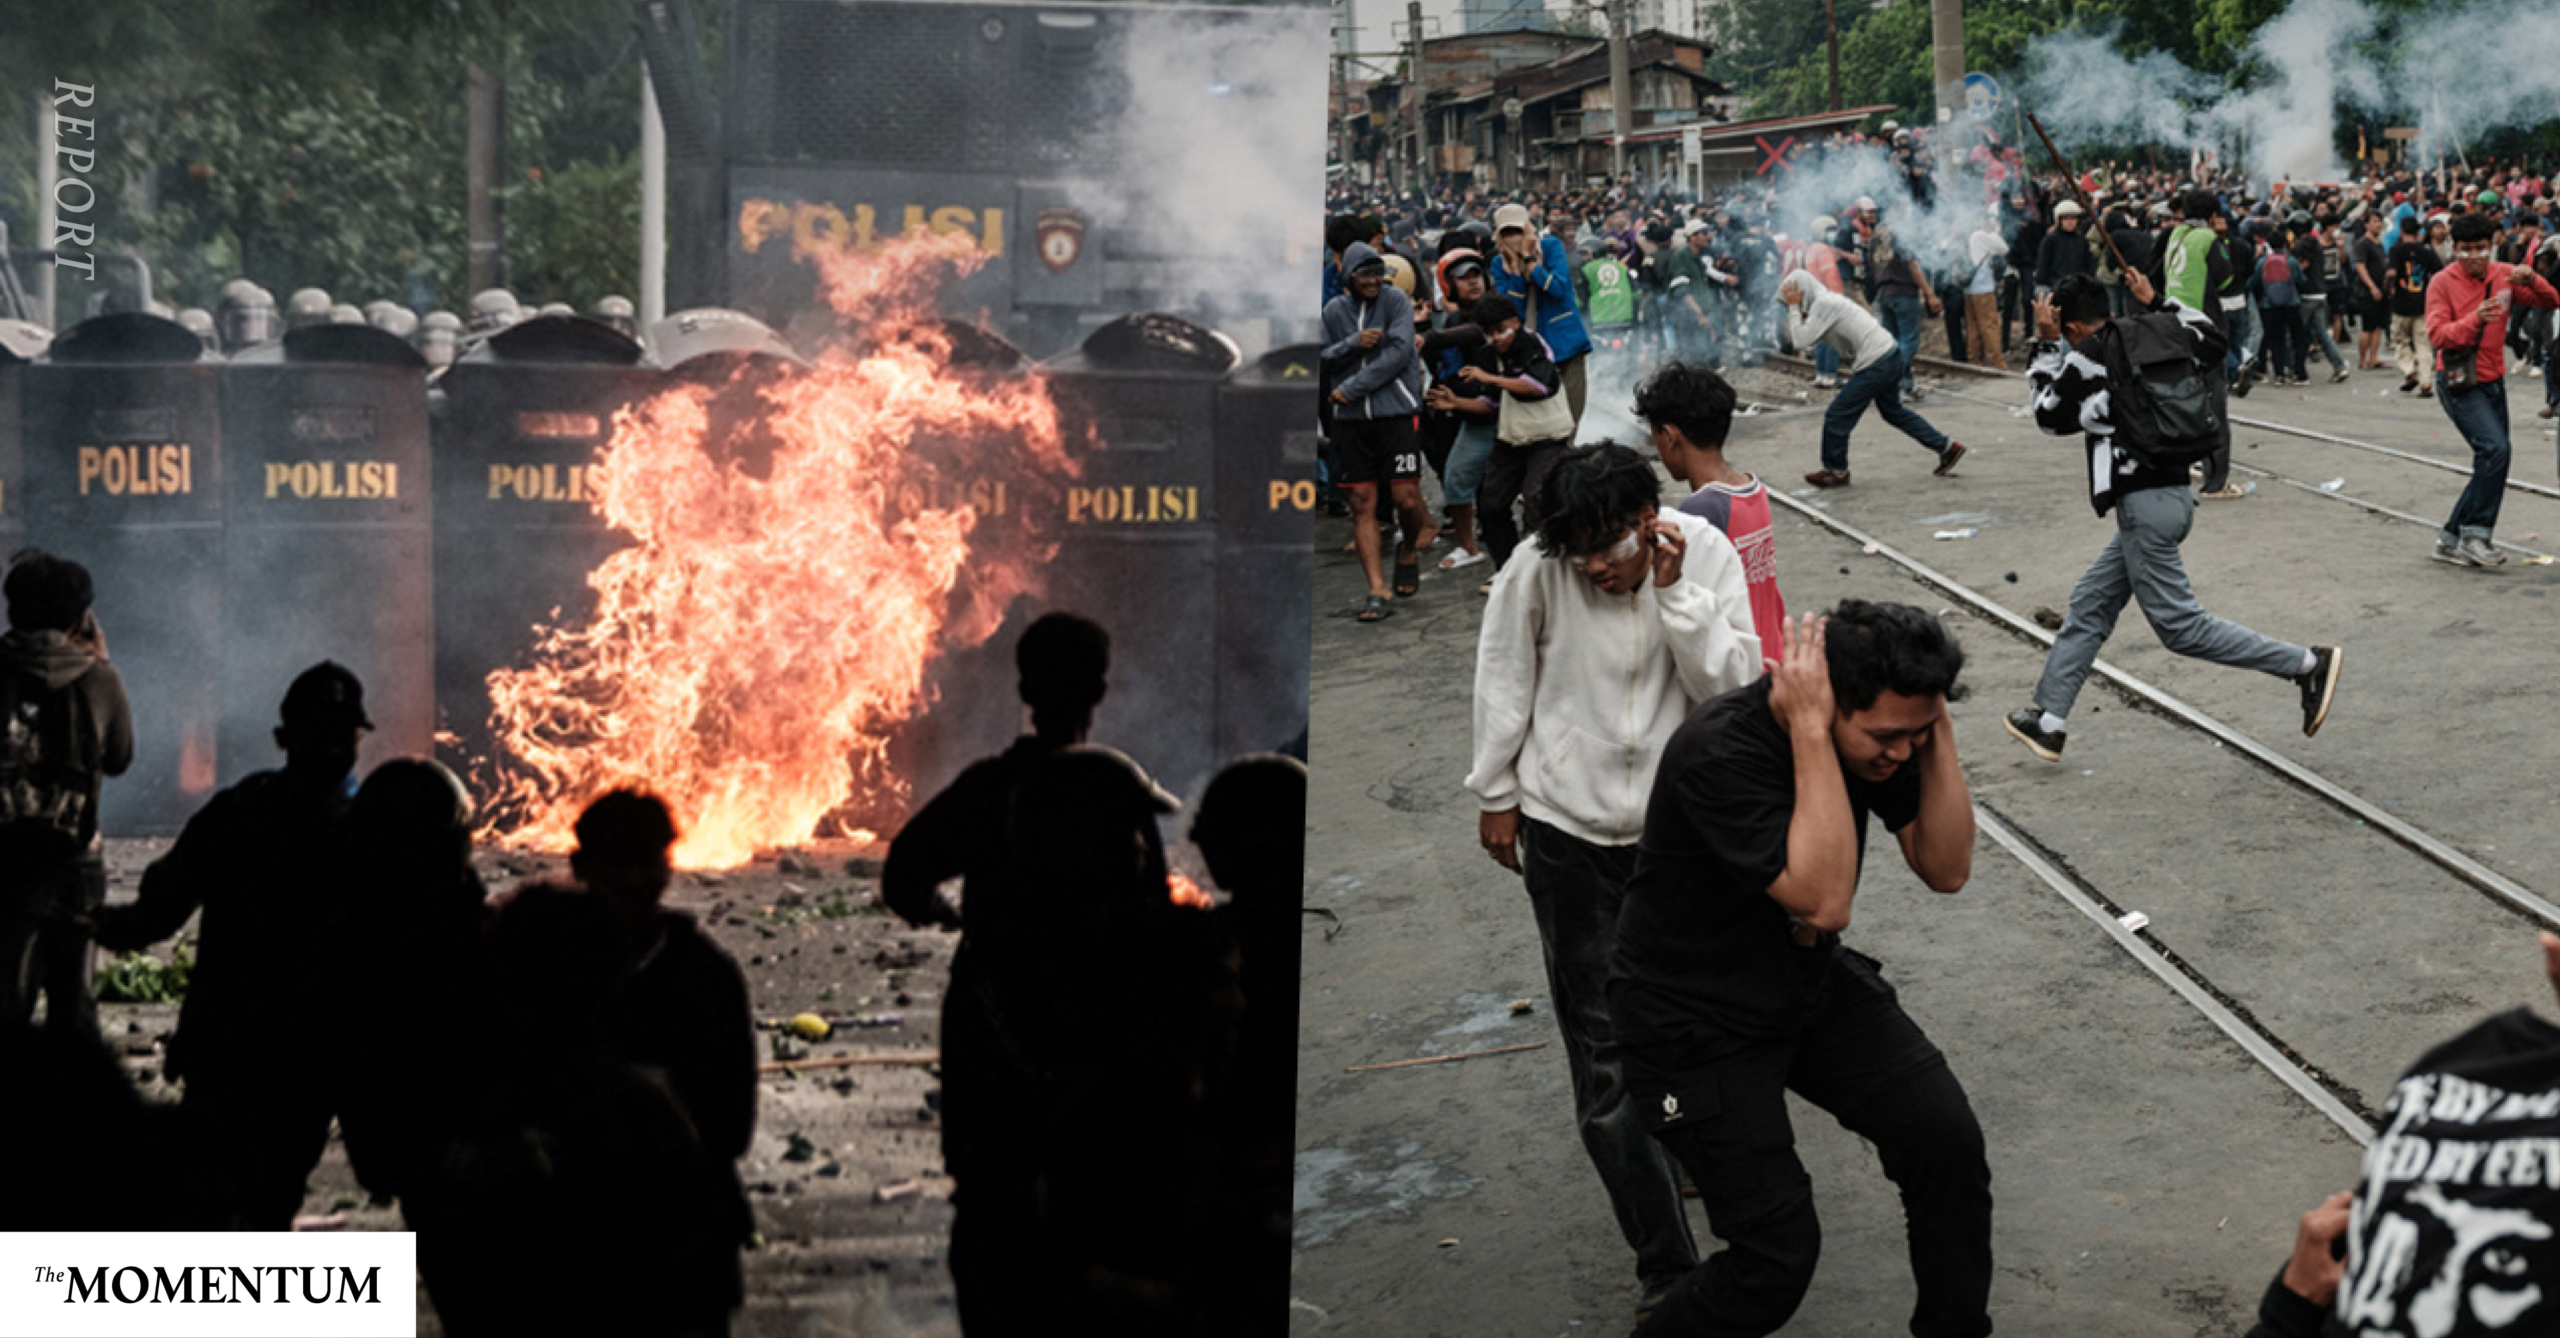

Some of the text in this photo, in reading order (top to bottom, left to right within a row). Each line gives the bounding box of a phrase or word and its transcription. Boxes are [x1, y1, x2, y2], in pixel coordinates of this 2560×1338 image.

[79, 444, 191, 495] POLISI
[265, 462, 397, 498] POLISI
[487, 462, 610, 501] POLIS
[1395, 454, 1417, 473] 20
[884, 480, 1007, 517] OLISI
[1067, 486, 1198, 523] POLISI
